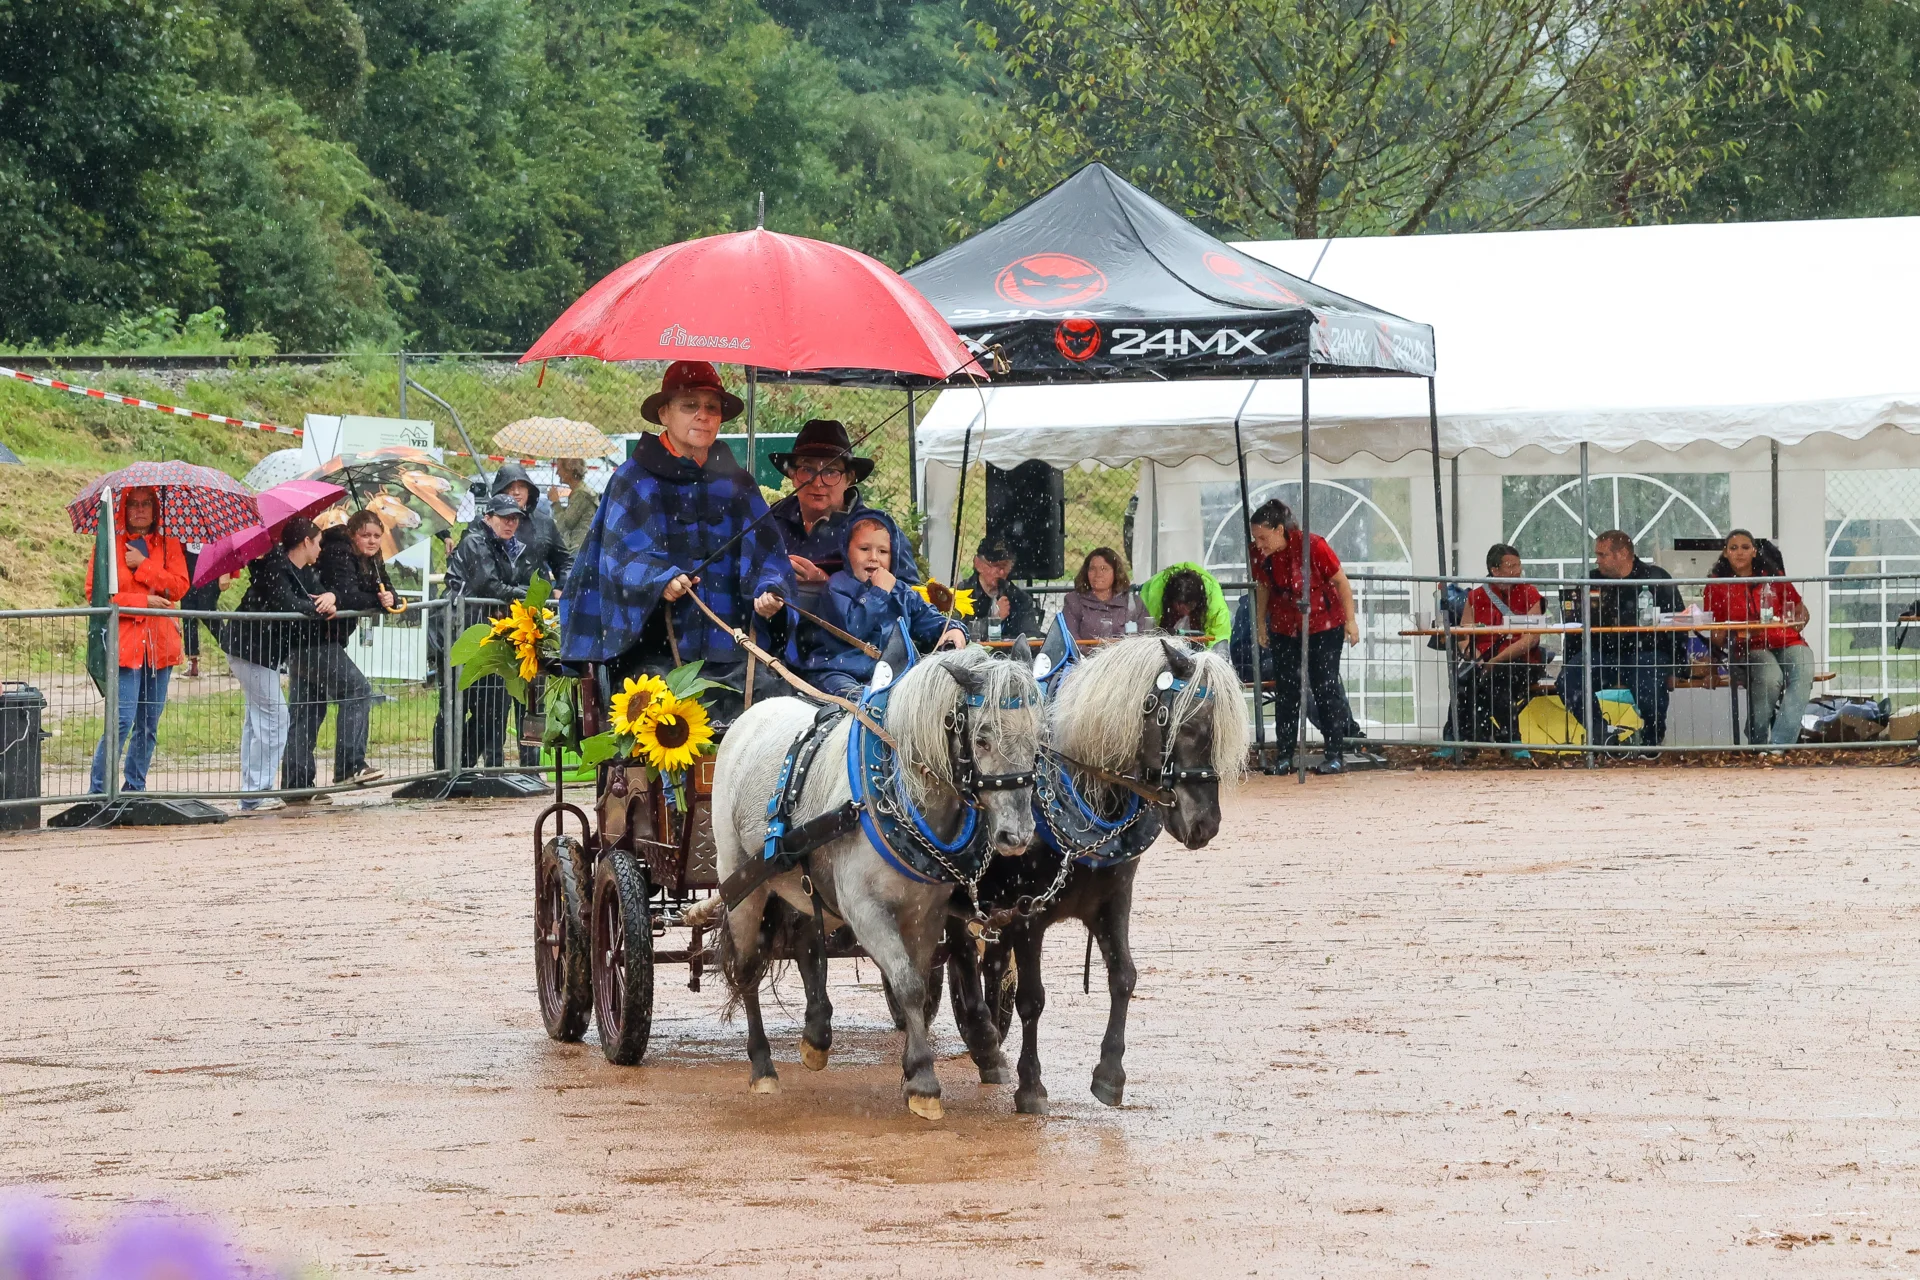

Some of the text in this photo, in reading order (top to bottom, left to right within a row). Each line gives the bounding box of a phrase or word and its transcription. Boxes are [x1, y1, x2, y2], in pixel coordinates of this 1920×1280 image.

[948, 309, 1117, 319] 24MX
[686, 335, 751, 350] KONSAC
[1110, 328, 1268, 356] 24MX
[1331, 327, 1368, 355] 24MX
[411, 439, 428, 448] VFD
